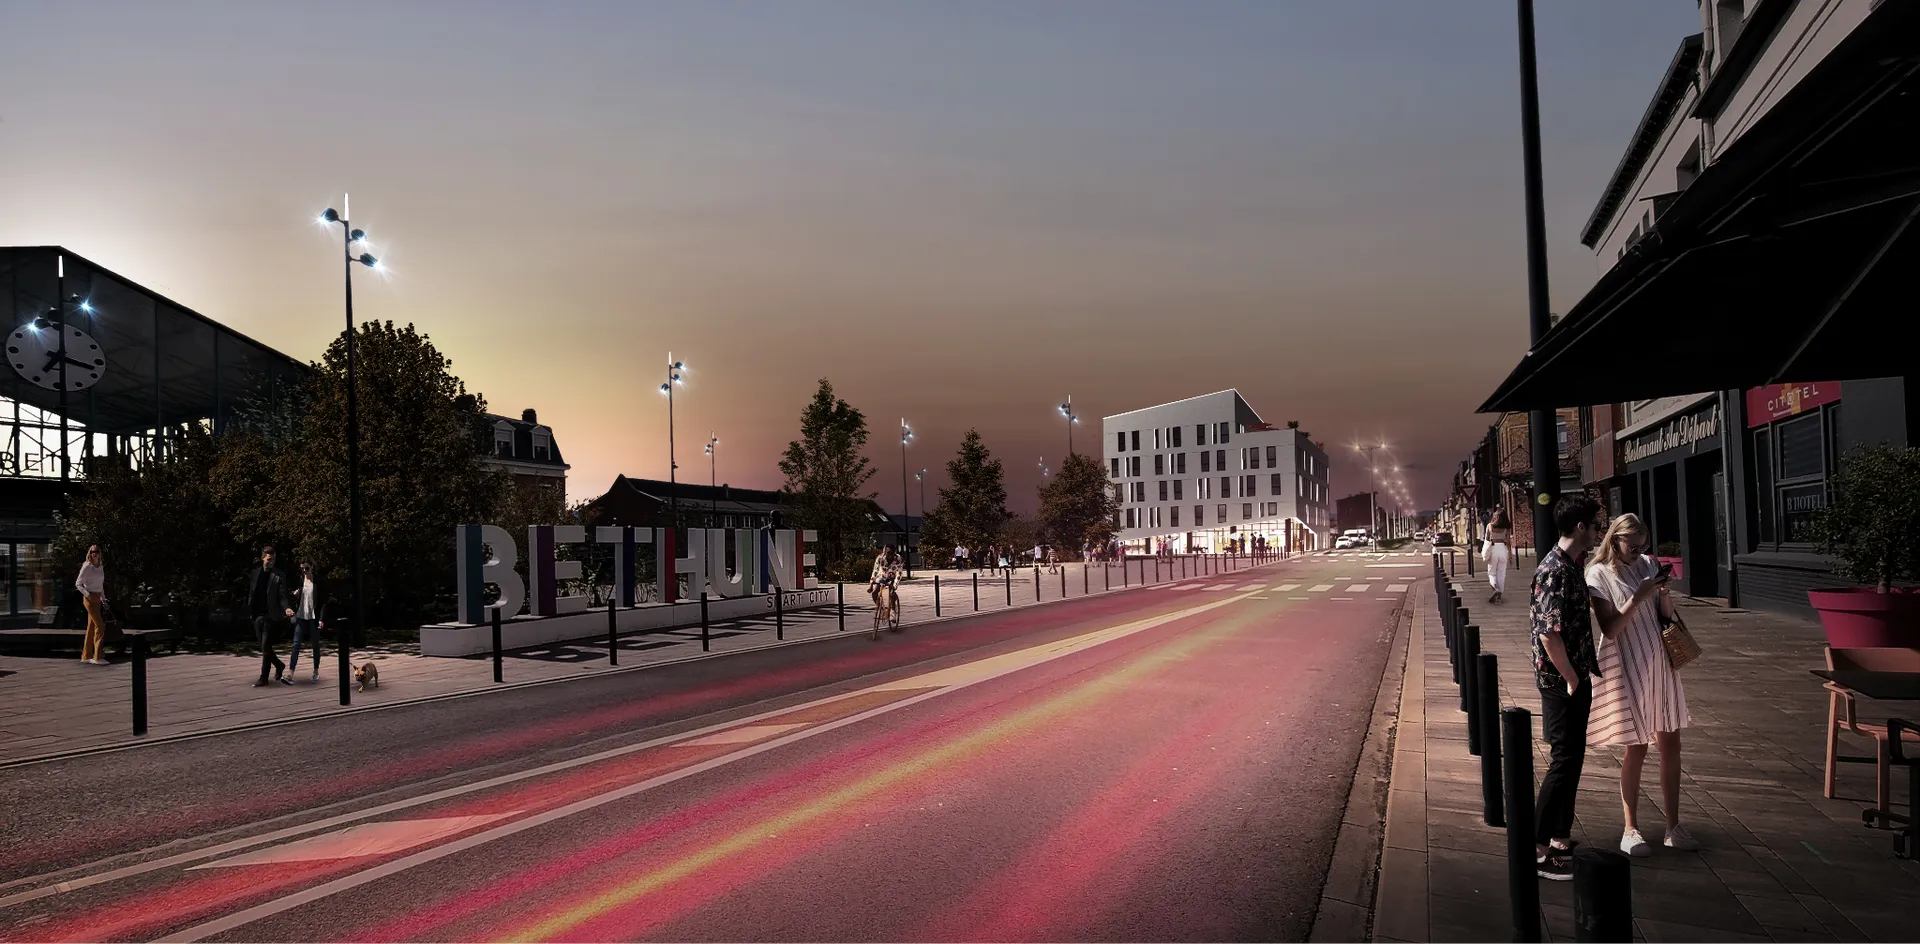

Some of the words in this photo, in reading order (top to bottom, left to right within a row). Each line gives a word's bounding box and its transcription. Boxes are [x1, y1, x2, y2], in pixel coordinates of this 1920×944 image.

[1624, 427, 1664, 464] Restaurant
[1663, 420, 1681, 450] Au
[1679, 404, 1718, 454] Départ
[1793, 494, 1824, 511] HOTEL
[456, 524, 818, 624] BETHUNE
[766, 593, 802, 608] SART
[809, 590, 829, 603] CITY
